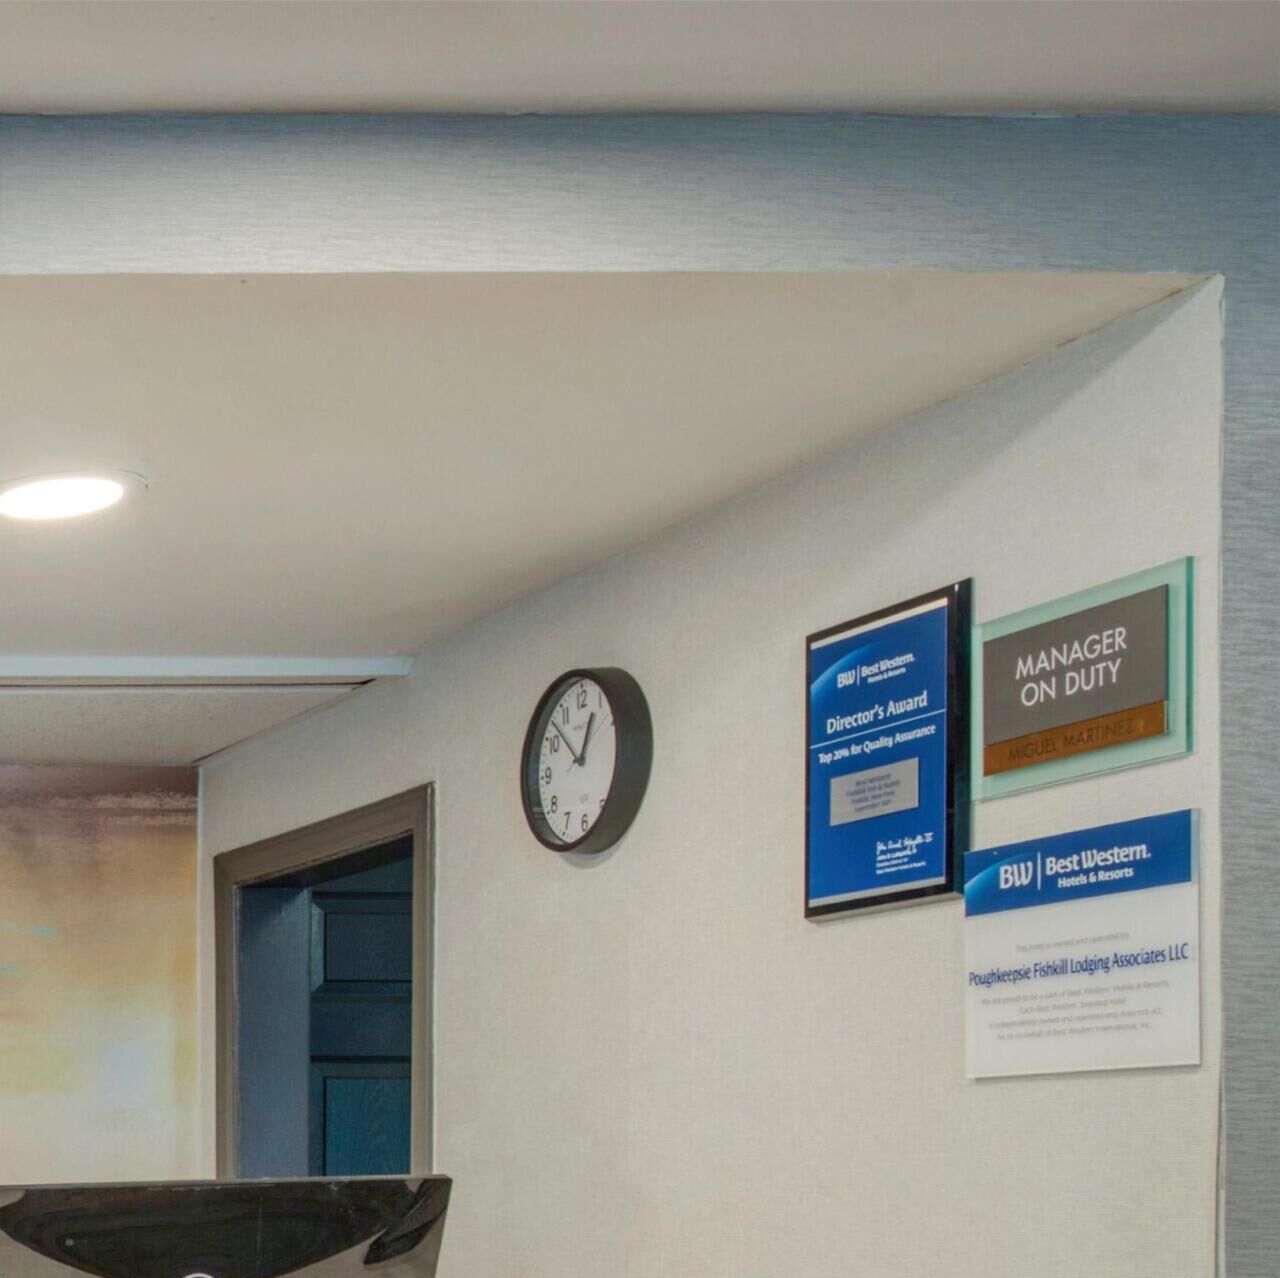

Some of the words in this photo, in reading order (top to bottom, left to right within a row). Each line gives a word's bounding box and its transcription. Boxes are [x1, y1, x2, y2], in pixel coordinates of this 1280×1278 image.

[1016, 628, 1126, 680] MANAGER
[837, 670, 855, 688] BW
[861, 664, 878, 677] Best
[1021, 677, 1055, 706] ON
[1066, 659, 1121, 695] DUTY
[577, 690, 588, 709] 12
[826, 705, 884, 734] Director's
[887, 690, 928, 717] Award
[549, 735, 559, 754] 10
[818, 753, 832, 765] Top
[850, 743, 862, 754] for
[864, 736, 893, 753] Quality
[895, 724, 936, 743] Assurance
[1009, 739, 1058, 761] MIGUEL
[1063, 719, 1136, 746] MARTINEZ
[999, 862, 1032, 889] BW
[1046, 856, 1080, 875] Best
[1058, 874, 1087, 888] Hotels
[1089, 872, 1096, 883] &
[1098, 868, 1133, 882] Resorts
[969, 968, 1031, 988] Poughkeepsie
[1034, 959, 1068, 979] Fishkill
[1070, 955, 1110, 975] Lodging
[1113, 948, 1165, 970] Associates
[1169, 943, 1188, 961] LLC
